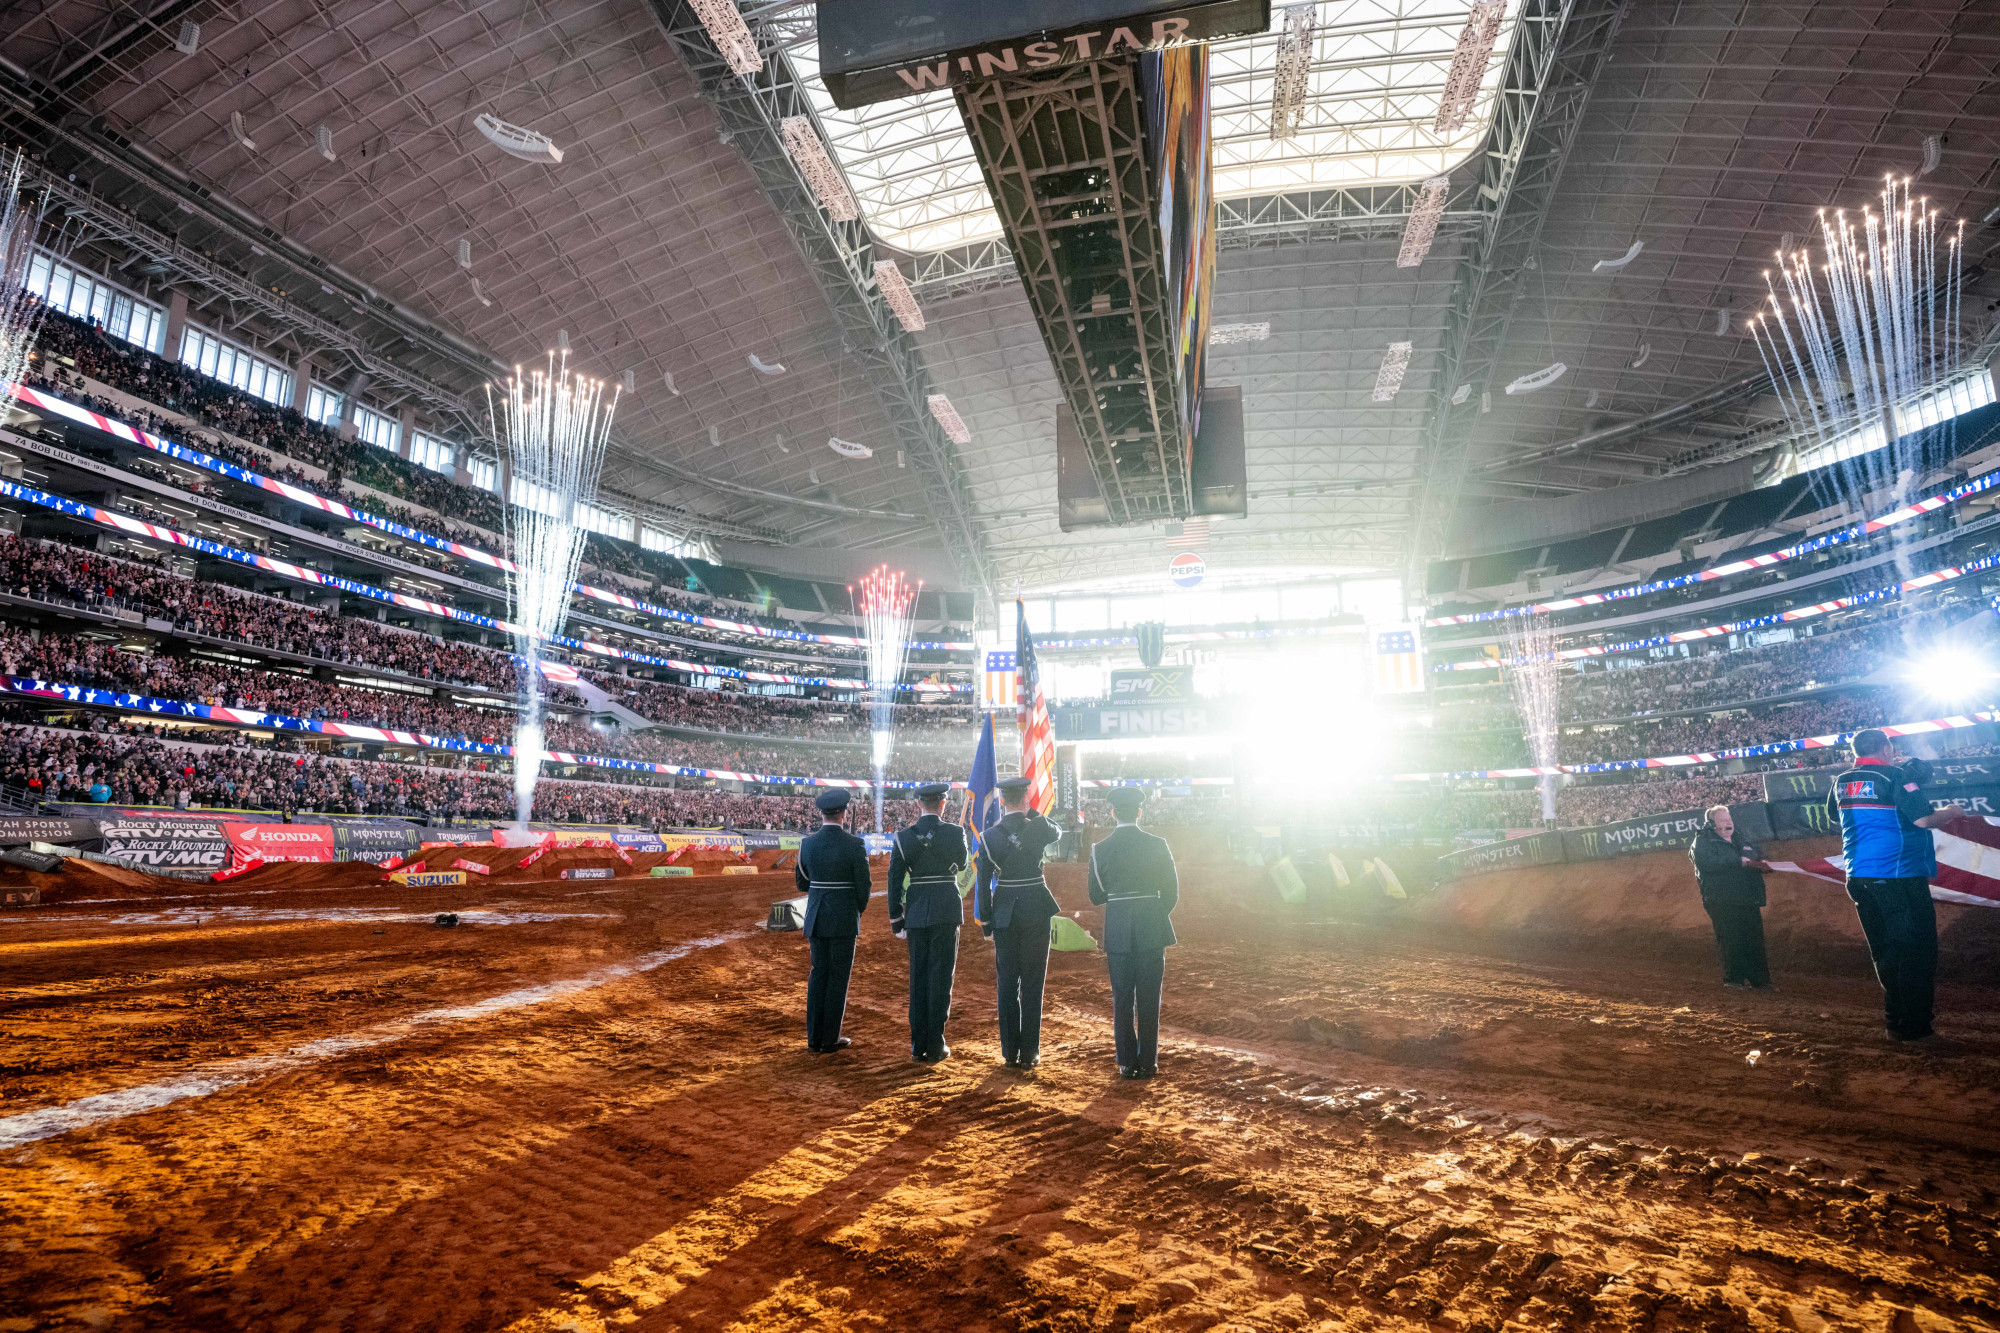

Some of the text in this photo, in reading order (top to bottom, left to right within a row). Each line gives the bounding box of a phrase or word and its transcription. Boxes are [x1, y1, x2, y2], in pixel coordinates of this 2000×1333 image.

[896, 17, 1191, 91] WINSTAR
[14, 436, 107, 472] 74 BOB LILLY 1961-1974
[202, 500, 218, 510] DON
[219, 505, 248, 519] PERKINS
[345, 545, 364, 556] ROGER
[365, 550, 392, 564] STAUBACH
[1170, 566, 1205, 575] PEPSI
[1113, 672, 1183, 697] SMX
[1100, 708, 1208, 734] FINISH
[25, 821, 70, 829] SPORTS
[118, 820, 217, 830] ROCKY MOUNTAIN
[1604, 817, 1701, 845] MONSTER
[259, 832, 324, 842] HONDA
[352, 828, 404, 840] MONSTER
[437, 832, 470, 843] TRIUMPH
[616, 834, 657, 842] FALKEN
[127, 840, 227, 851] ROCKY MOUNTAIN
[557, 840, 572, 848] FLY
[592, 840, 605, 848] FLY
[704, 837, 743, 846] SUZUKI
[1622, 836, 1690, 852] ENERGY
[529, 848, 544, 864] FLY
[620, 848, 632, 860] FLY
[1463, 844, 1524, 867] MONSTER
[223, 863, 247, 876] FLY
[466, 861, 483, 872] FLY
[406, 874, 459, 887] SUZUKI
